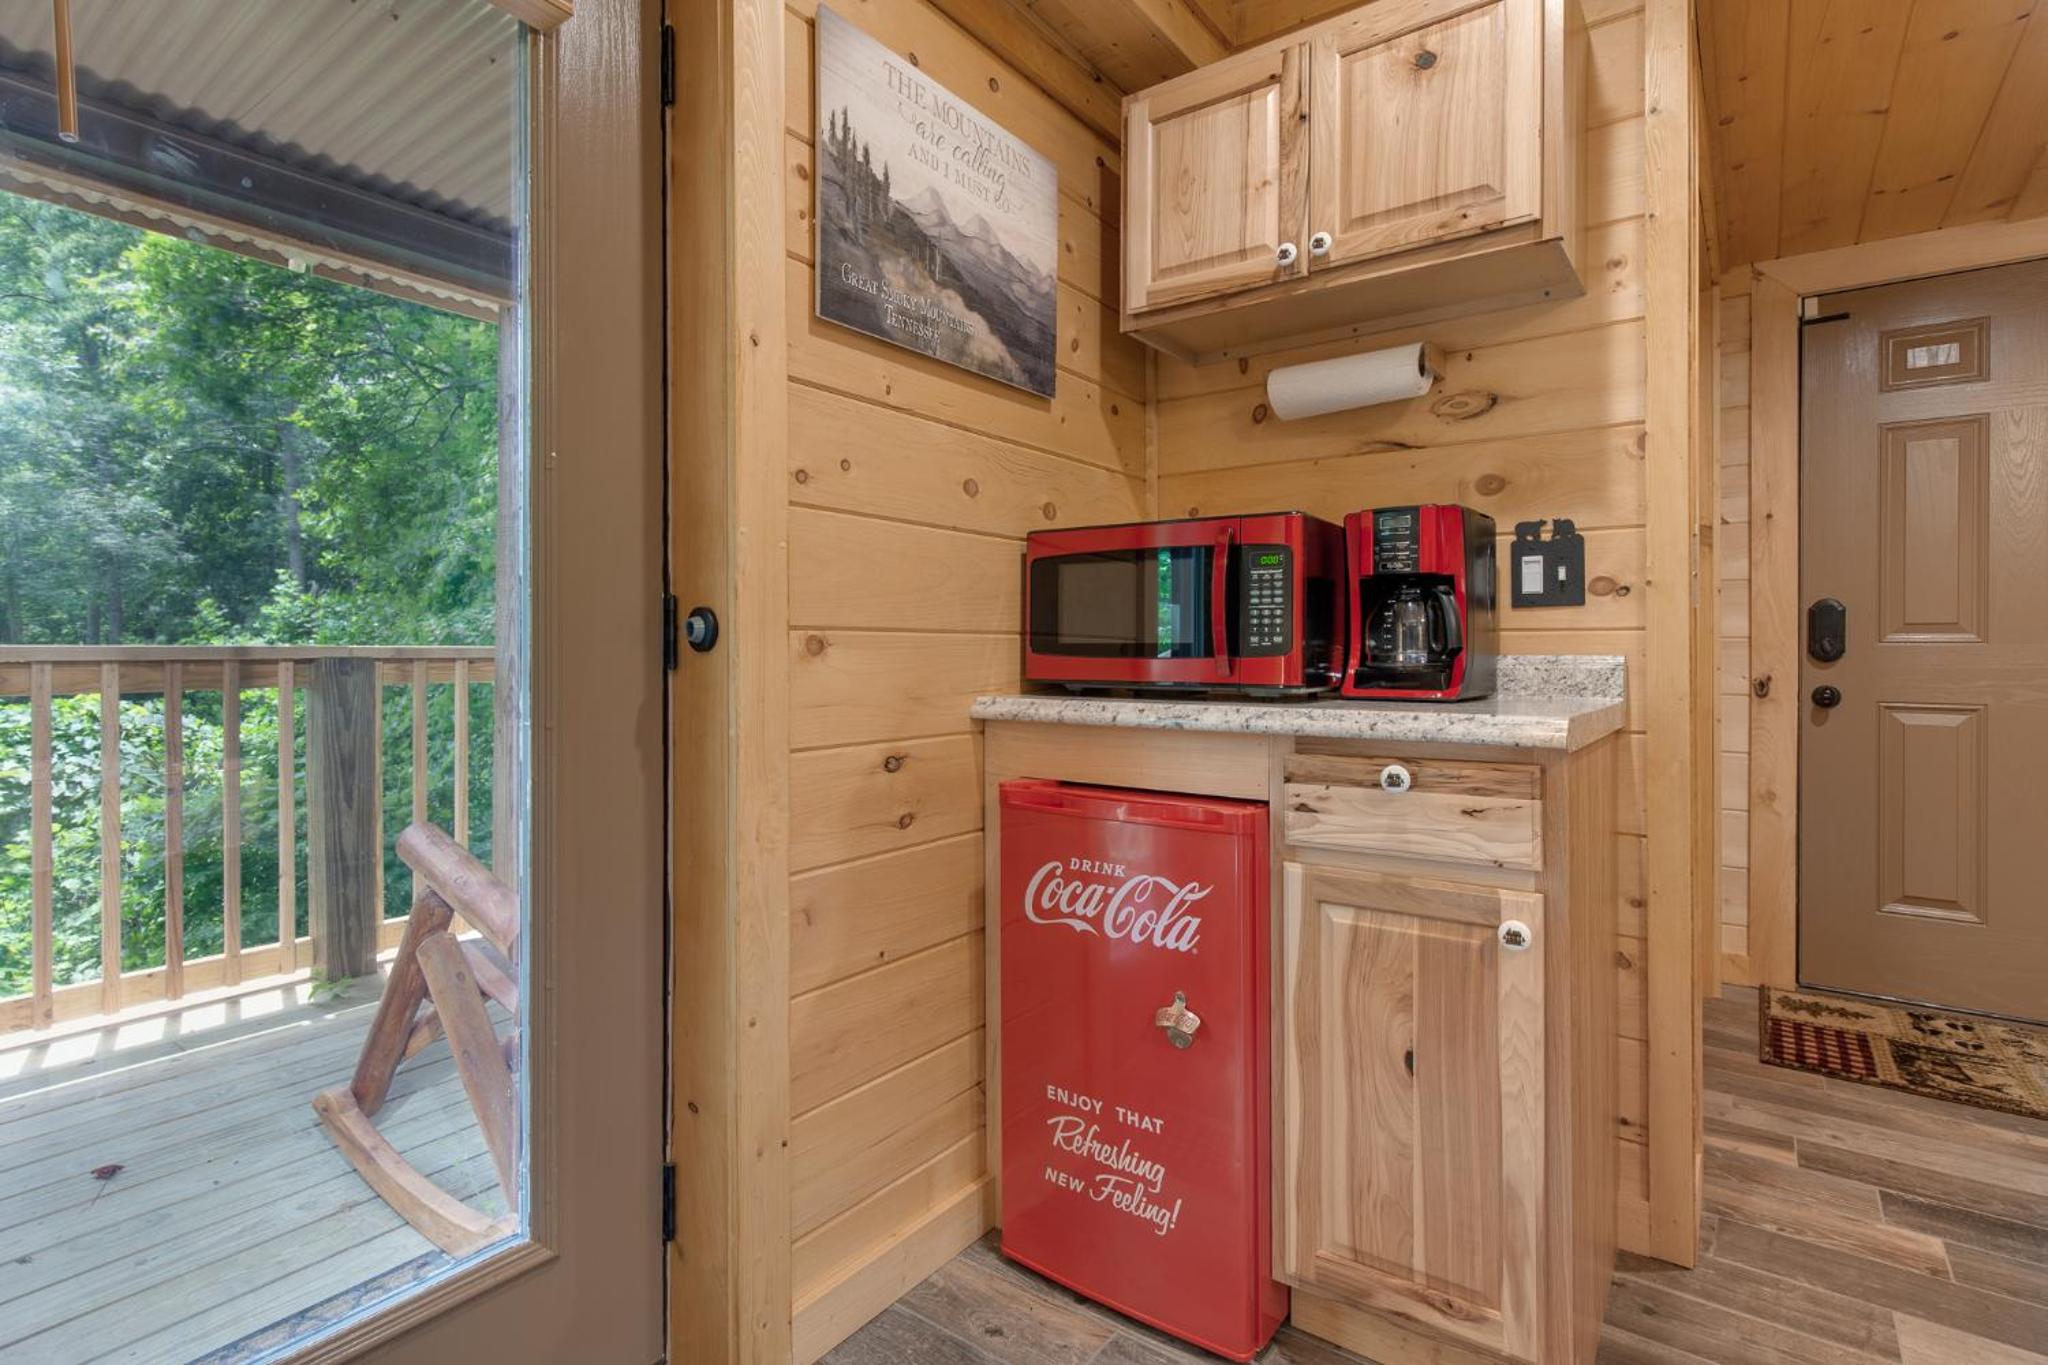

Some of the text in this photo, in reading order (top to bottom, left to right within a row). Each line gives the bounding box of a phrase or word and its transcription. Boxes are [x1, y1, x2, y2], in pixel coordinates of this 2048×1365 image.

[883, 61, 1031, 178] THE MOUNTAINS
[907, 143, 939, 172] AND
[915, 121, 1006, 202] are calling
[1069, 857, 1127, 878] DRINK
[1024, 861, 1214, 953] Coca-Cola
[1047, 1085, 1164, 1135] ENJOY THAT
[1047, 1115, 1165, 1193] Refreshing
[1045, 1167, 1182, 1236] NEW Feeling!
